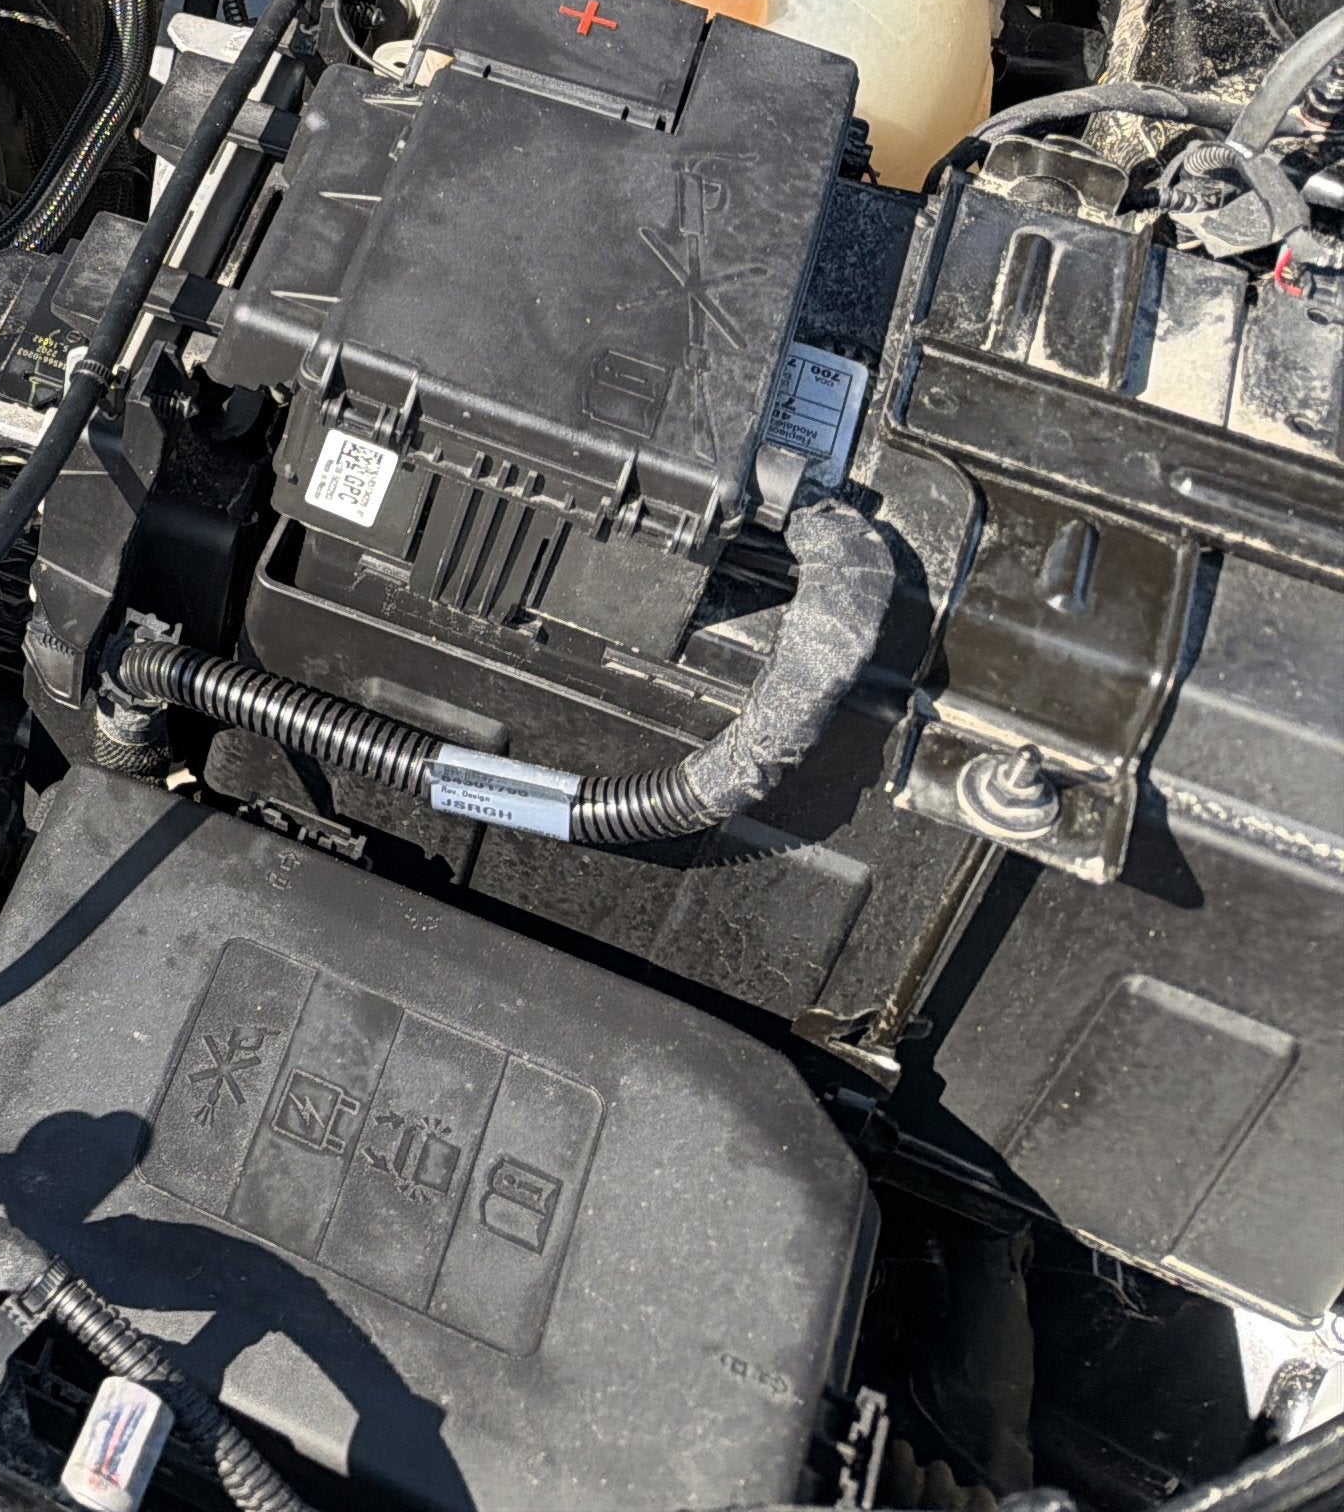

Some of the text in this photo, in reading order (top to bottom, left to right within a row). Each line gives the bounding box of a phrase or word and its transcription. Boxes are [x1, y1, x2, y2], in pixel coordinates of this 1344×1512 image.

[811, 365, 840, 383] 700
[338, 475, 365, 505] GPC
[441, 798, 513, 821] JSRGH
